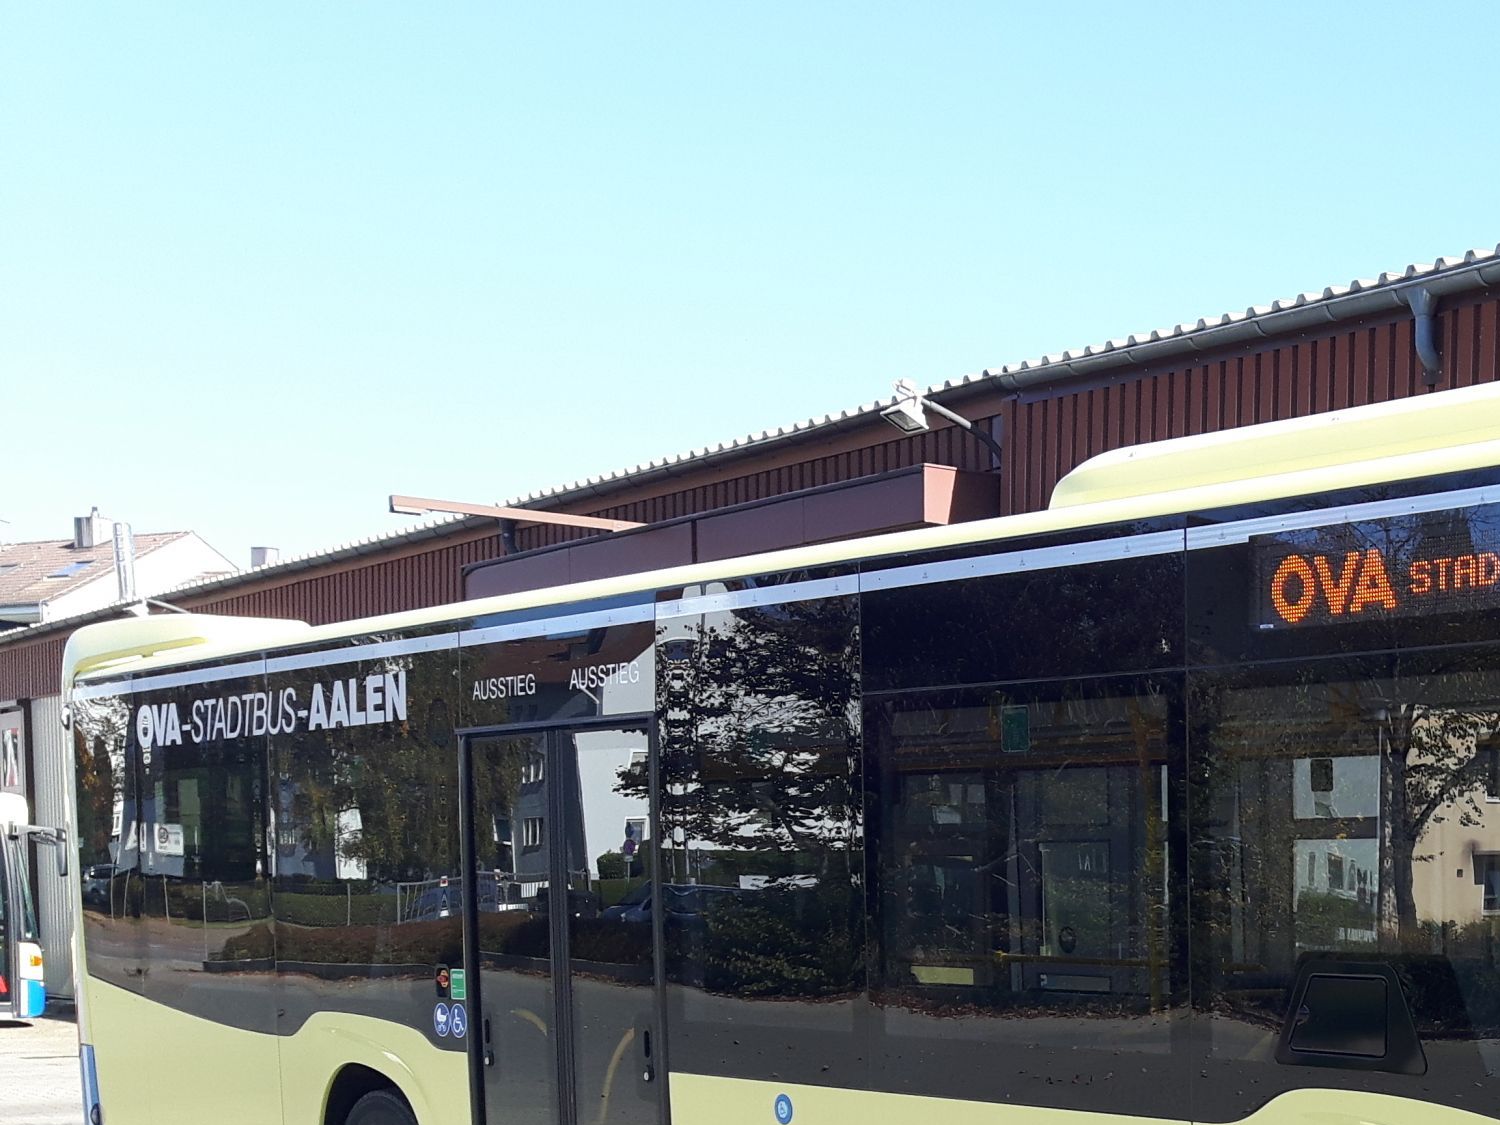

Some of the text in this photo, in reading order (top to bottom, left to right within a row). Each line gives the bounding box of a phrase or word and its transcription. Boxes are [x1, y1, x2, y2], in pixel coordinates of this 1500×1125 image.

[1271, 548, 1396, 625] OVA
[472, 674, 536, 701] AUSSTIEG
[569, 661, 640, 691] AUSSTIEG
[136, 671, 406, 747] OVA-STADTBUS-AALEN
